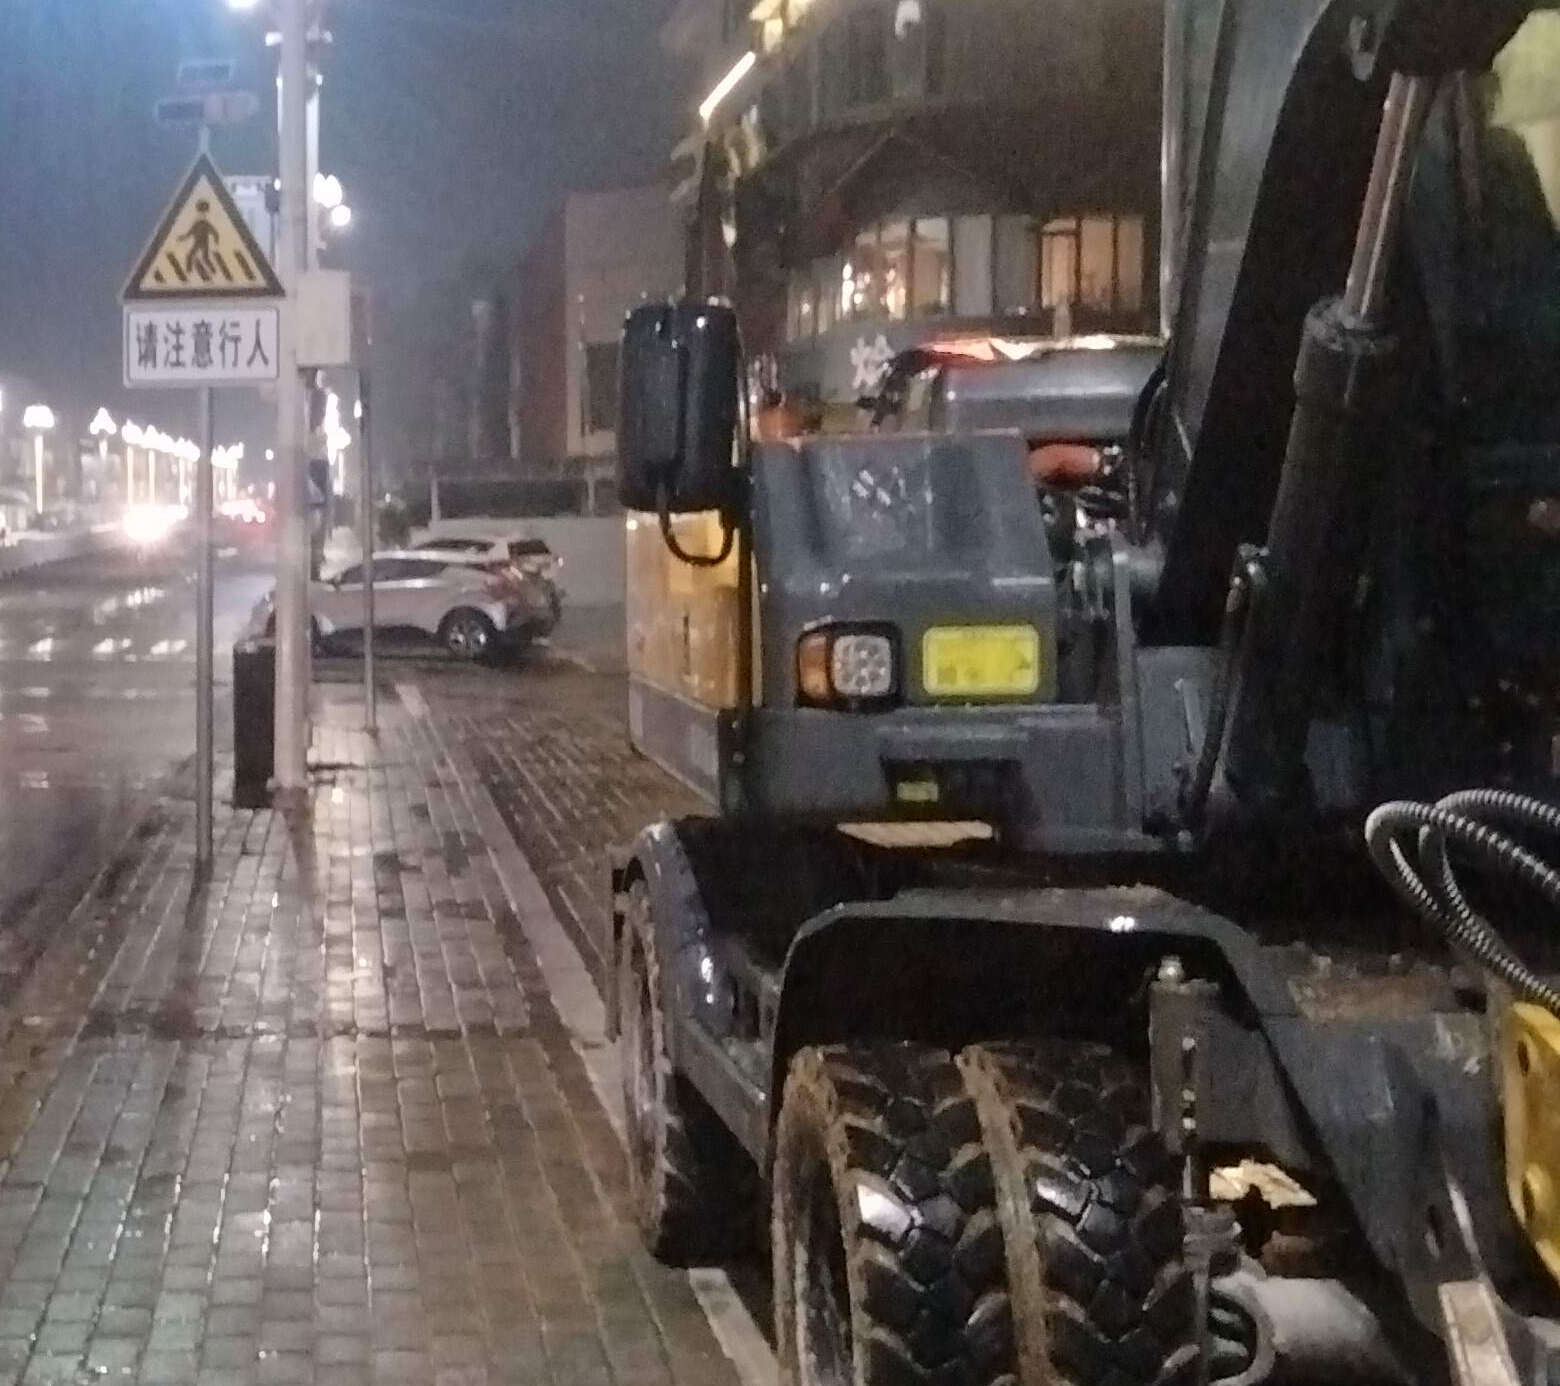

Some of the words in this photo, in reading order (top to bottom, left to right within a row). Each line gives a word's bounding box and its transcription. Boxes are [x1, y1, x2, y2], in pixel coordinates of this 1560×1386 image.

[136, 319, 269, 369] 请注意行人
